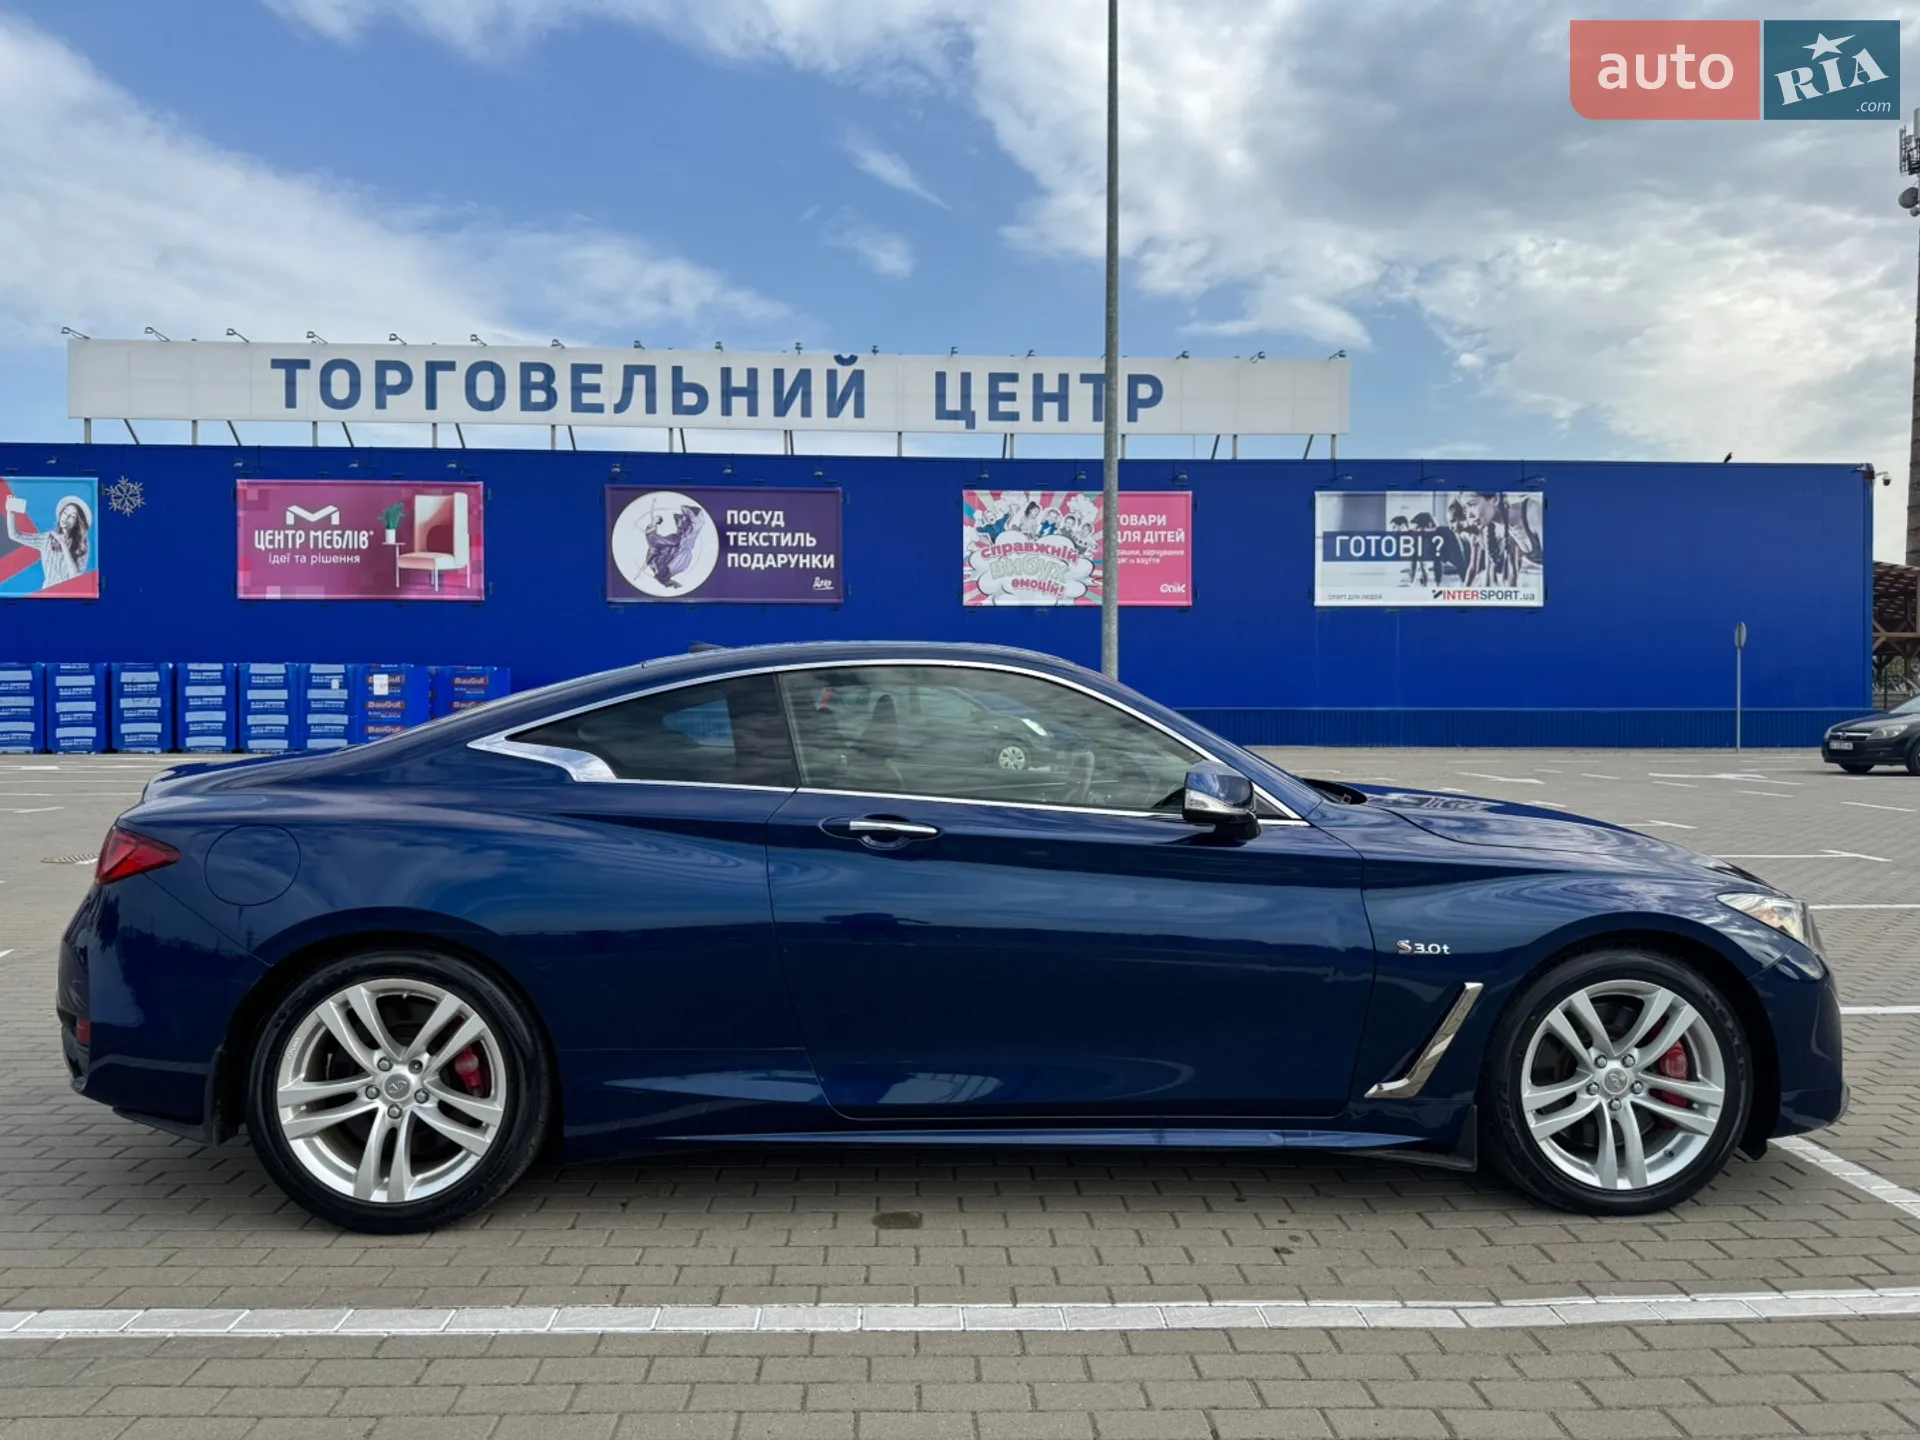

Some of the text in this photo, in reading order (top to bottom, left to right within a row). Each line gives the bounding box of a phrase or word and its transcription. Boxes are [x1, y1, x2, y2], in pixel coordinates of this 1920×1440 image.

[270, 354, 1164, 431] ТОРГОВЕЛЬНИЙ ЦЕНТР
[726, 510, 785, 528] ПОСУД
[1117, 514, 1167, 527] ОВАРИ
[254, 529, 369, 551] ЦЕНТР МЕБЛІВ
[726, 531, 818, 548] ТЕКСТИЛЬ
[1143, 527, 1186, 545] ДІТЕЙ
[980, 542, 1080, 563] справжній
[1335, 535, 1445, 557] ГОТОВІ ?
[268, 552, 361, 566] ідеї та рішення
[727, 553, 835, 570] ПОДАРУНКИ
[989, 554, 1070, 583] вибух
[1010, 578, 1066, 597] емоцій!
[1442, 589, 1535, 601] INTERSPORT.ua
